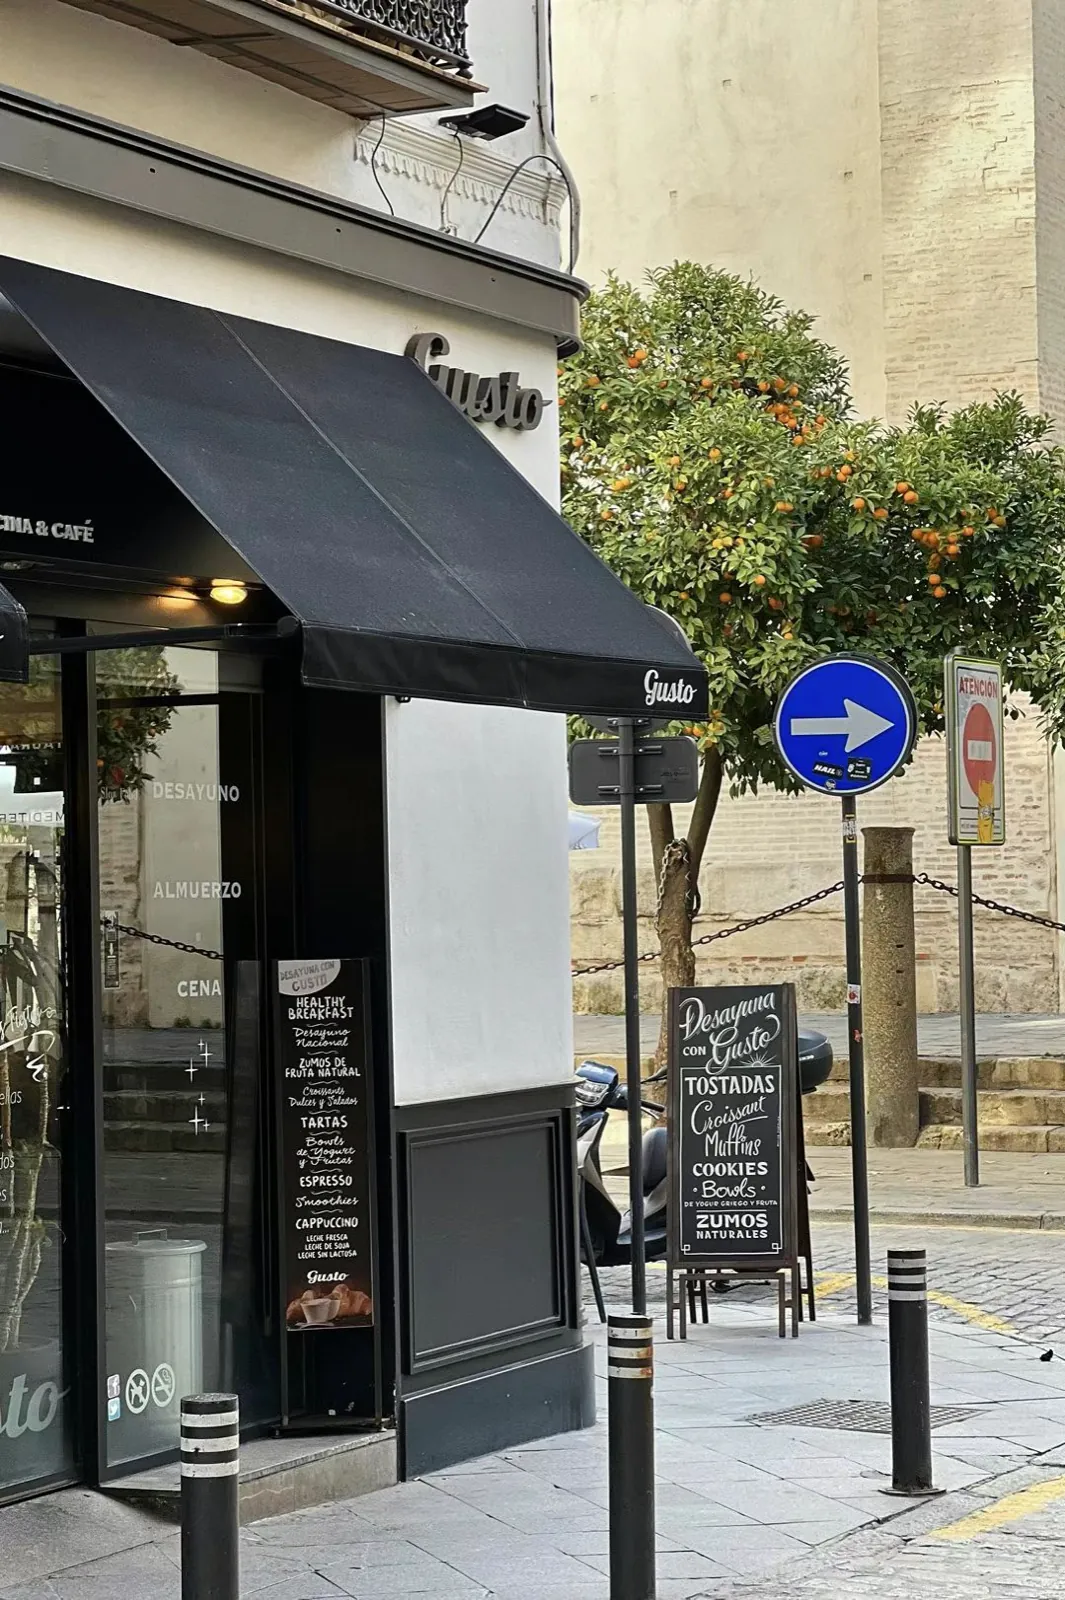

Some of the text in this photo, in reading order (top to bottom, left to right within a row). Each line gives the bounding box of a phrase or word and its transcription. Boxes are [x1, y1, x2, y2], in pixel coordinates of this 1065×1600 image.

[36, 520, 49, 536] &
[51, 519, 95, 543] CAFÉ
[644, 669, 698, 706] Gusto
[153, 782, 240, 802] DESAYUNO
[153, 881, 242, 899] ALMUERZO
[177, 980, 222, 997] CENA
[296, 996, 346, 1008] HEALTHY
[288, 1006, 354, 1020] BREAKFAST
[679, 992, 776, 1040] Desayuna
[292, 1027, 351, 1040] Desayuno
[296, 1036, 349, 1048] Nacional
[682, 1013, 781, 1075] CON Gusto
[299, 1057, 347, 1069] ZUMOS DE
[285, 1067, 361, 1078] FRUTA NATURAL
[684, 1074, 776, 1096] TOSTADAS
[318, 1099, 326, 1109] y
[301, 1115, 349, 1129] TARTAS
[690, 1095, 768, 1135] Croissant
[305, 1135, 346, 1147] Bowls
[705, 1122, 762, 1157] Muffins
[692, 1161, 769, 1177] COOKIES
[299, 1174, 353, 1188] ESPRESSO
[701, 1177, 757, 1198] Bowls
[295, 1195, 359, 1208] Smoothies
[295, 1216, 359, 1230] CAPPUCCINO
[696, 1213, 769, 1228] ZUMOS
[306, 1233, 349, 1242] LECHE FRESCA
[696, 1229, 769, 1239] NATURALES
[304, 1243, 322, 1251] LECHE
[324, 1242, 333, 1250] DE
[298, 1251, 316, 1260] LECHE
[306, 1270, 350, 1284] Gusto
